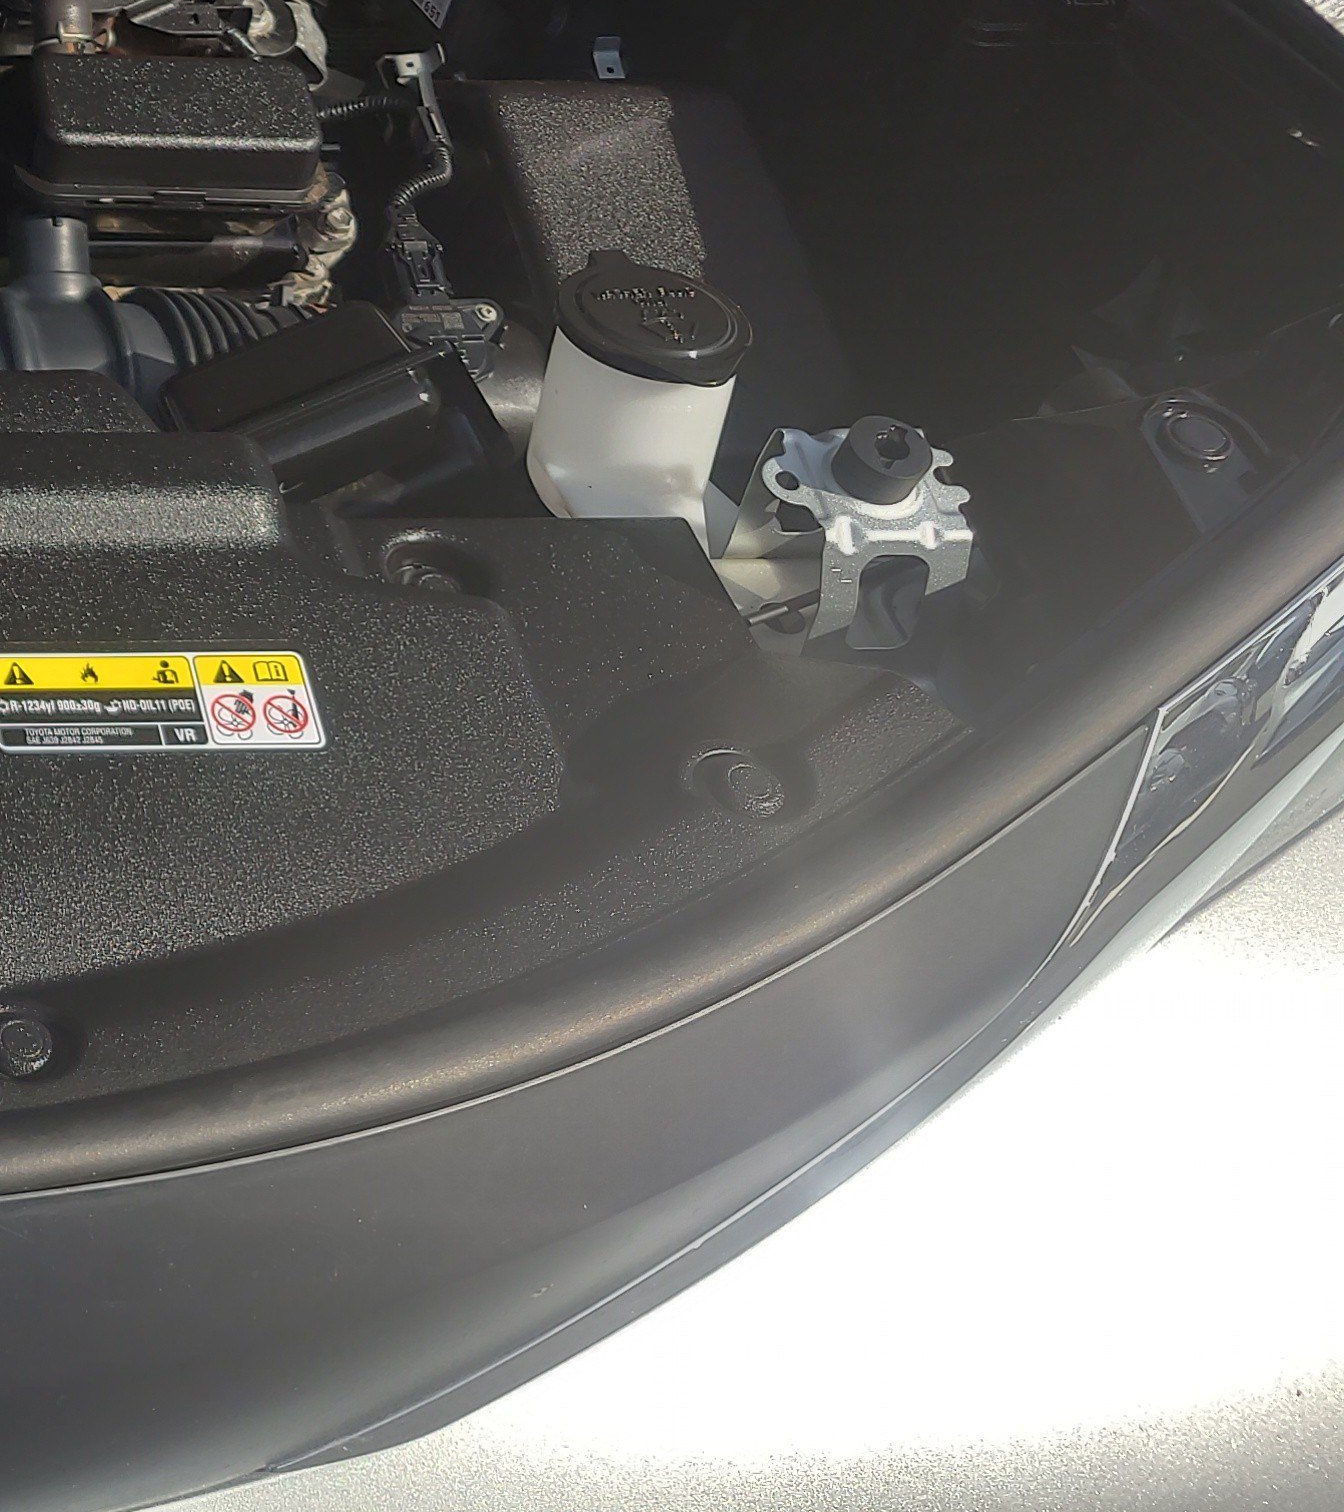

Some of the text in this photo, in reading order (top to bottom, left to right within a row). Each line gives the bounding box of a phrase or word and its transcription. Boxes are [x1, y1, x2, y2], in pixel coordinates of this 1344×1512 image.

[9, 699, 56, 714] R-1234yf
[168, 699, 196, 713] (POE)
[24, 728, 133, 737] TOYOTA MOTOR CORPORATION
[174, 728, 196, 742] VR
[25, 737, 41, 745] SAE
